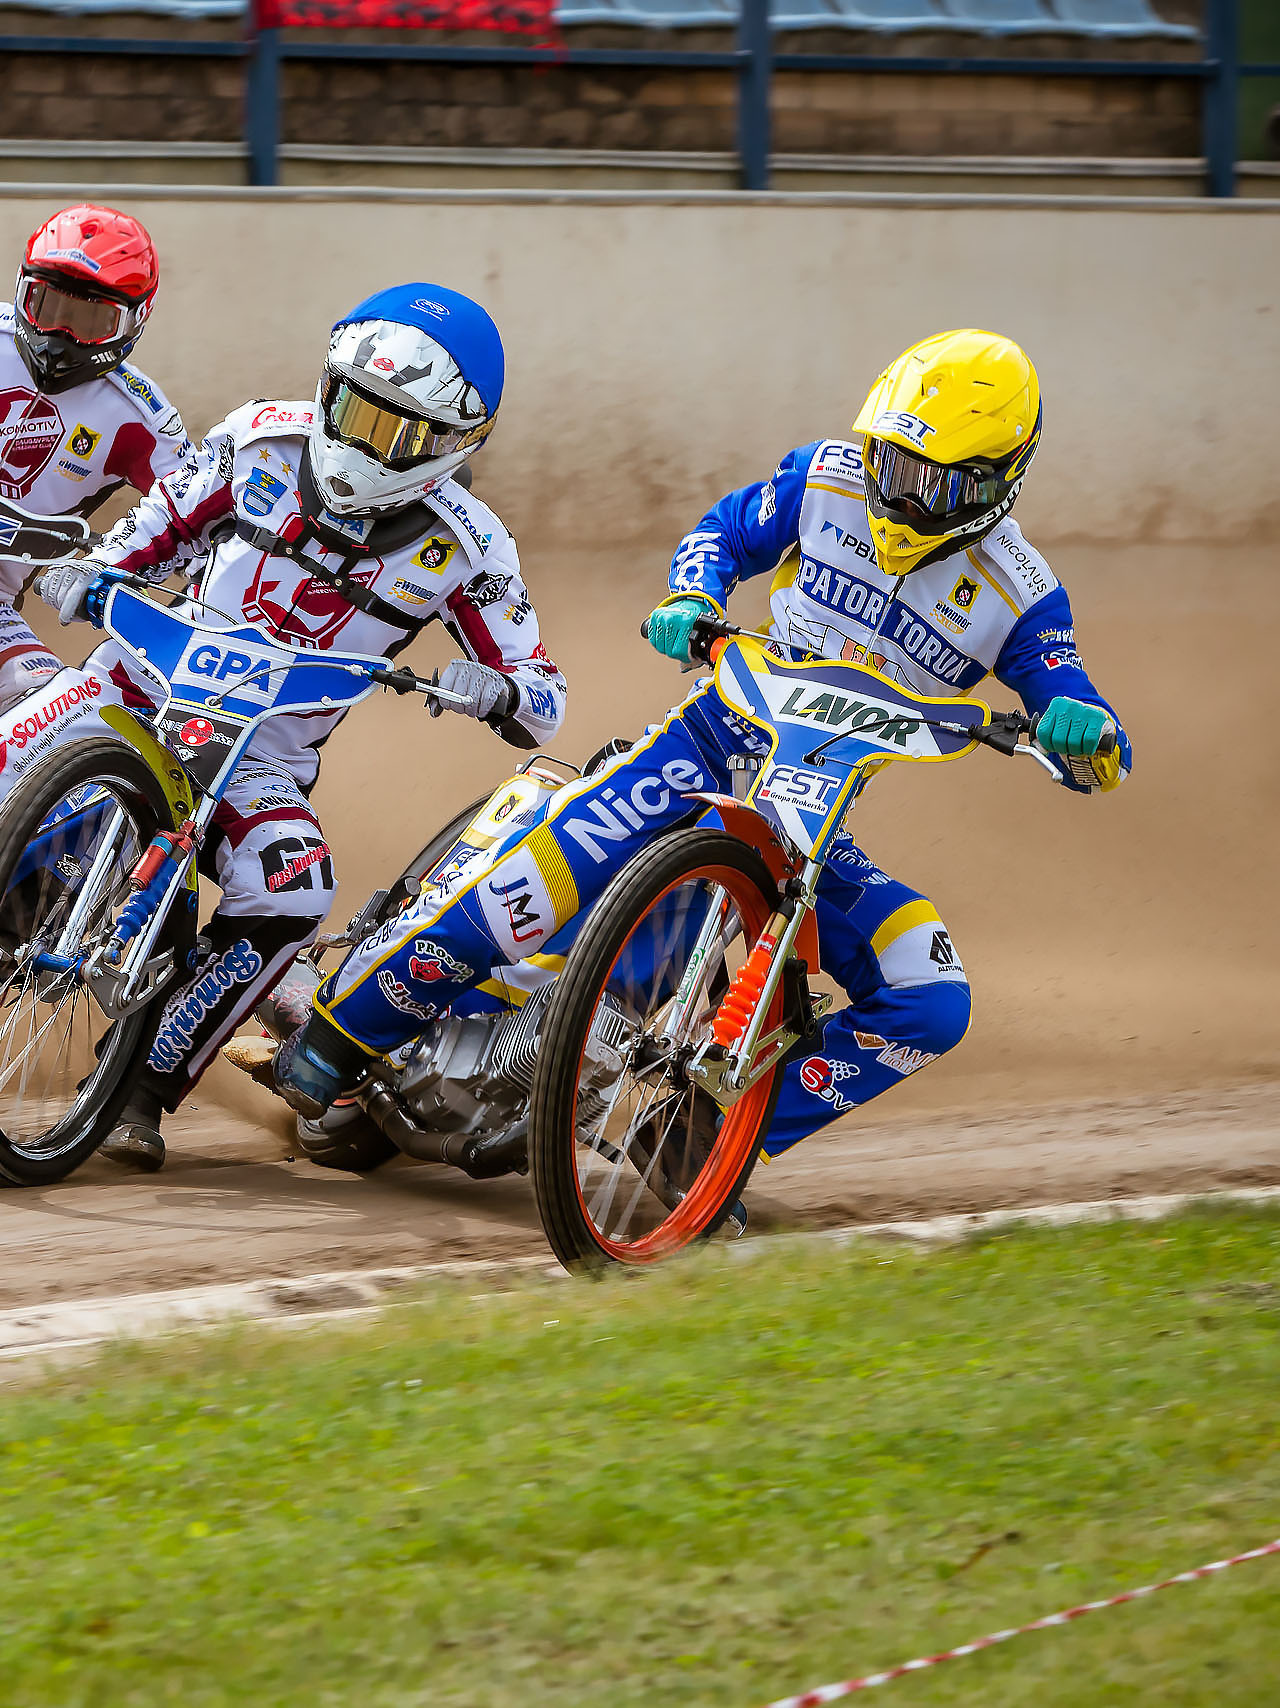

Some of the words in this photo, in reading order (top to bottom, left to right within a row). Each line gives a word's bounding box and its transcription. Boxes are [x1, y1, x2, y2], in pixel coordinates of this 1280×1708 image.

[818, 444, 863, 470] FS
[996, 533, 1048, 594] NICOLAUS
[795, 557, 885, 626] PATOR
[187, 644, 273, 693] GPA
[778, 686, 921, 748] LAVOR
[562, 758, 705, 865] Nice
[765, 767, 839, 802] FST
[769, 790, 792, 804] Grupa
[791, 795, 826, 813] Brokerska
